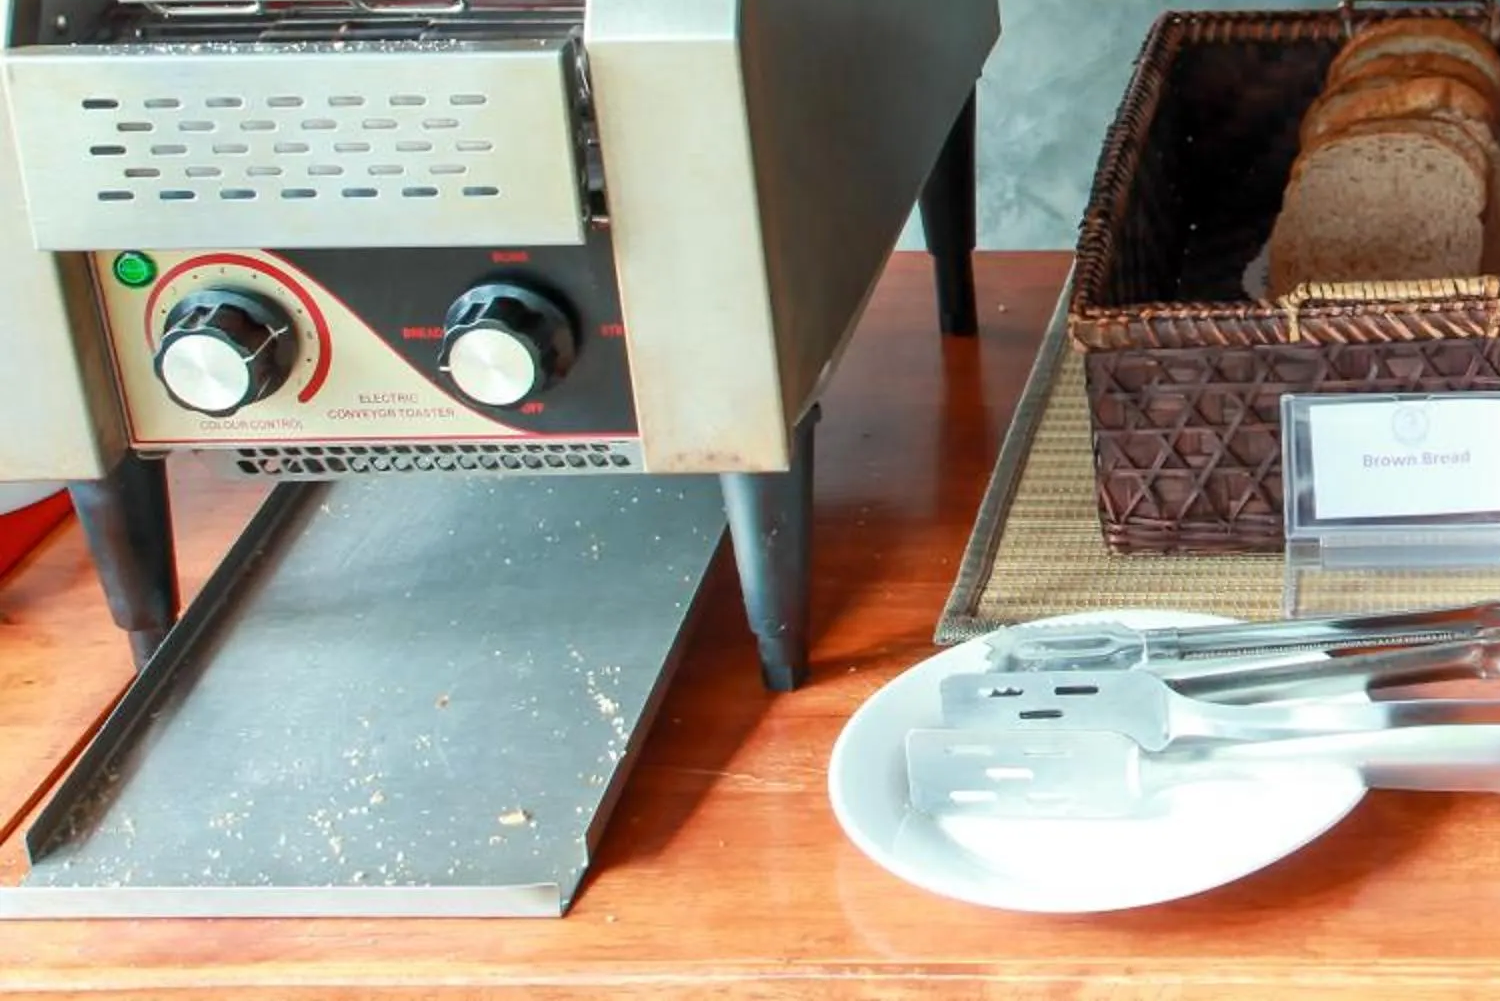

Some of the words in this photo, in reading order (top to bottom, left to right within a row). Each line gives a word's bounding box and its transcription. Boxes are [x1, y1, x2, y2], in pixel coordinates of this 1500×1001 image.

[359, 393, 418, 404] ELECTRIC
[199, 419, 248, 431] COLOUR
[1362, 453, 1418, 468] Brown
[1421, 449, 1471, 465] Bread
